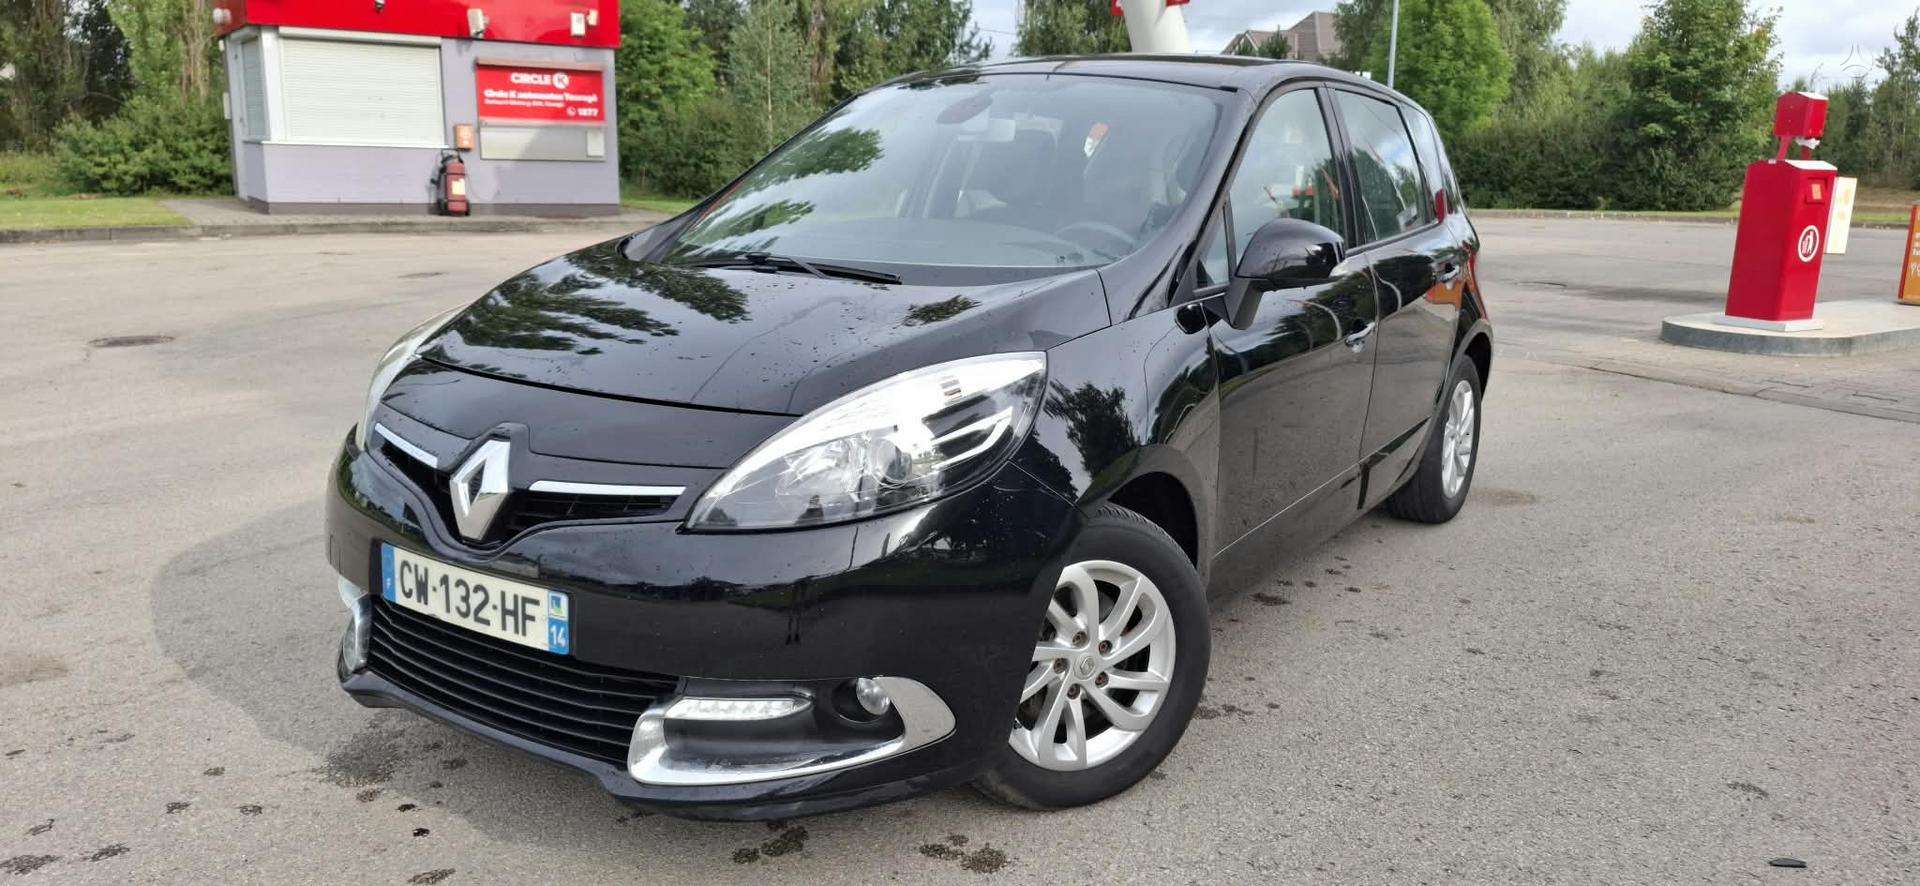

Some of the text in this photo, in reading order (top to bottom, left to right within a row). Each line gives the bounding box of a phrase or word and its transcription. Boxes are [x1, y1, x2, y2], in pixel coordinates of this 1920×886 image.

[511, 72, 569, 89] CIRCLE K
[549, 624, 567, 648] 14
